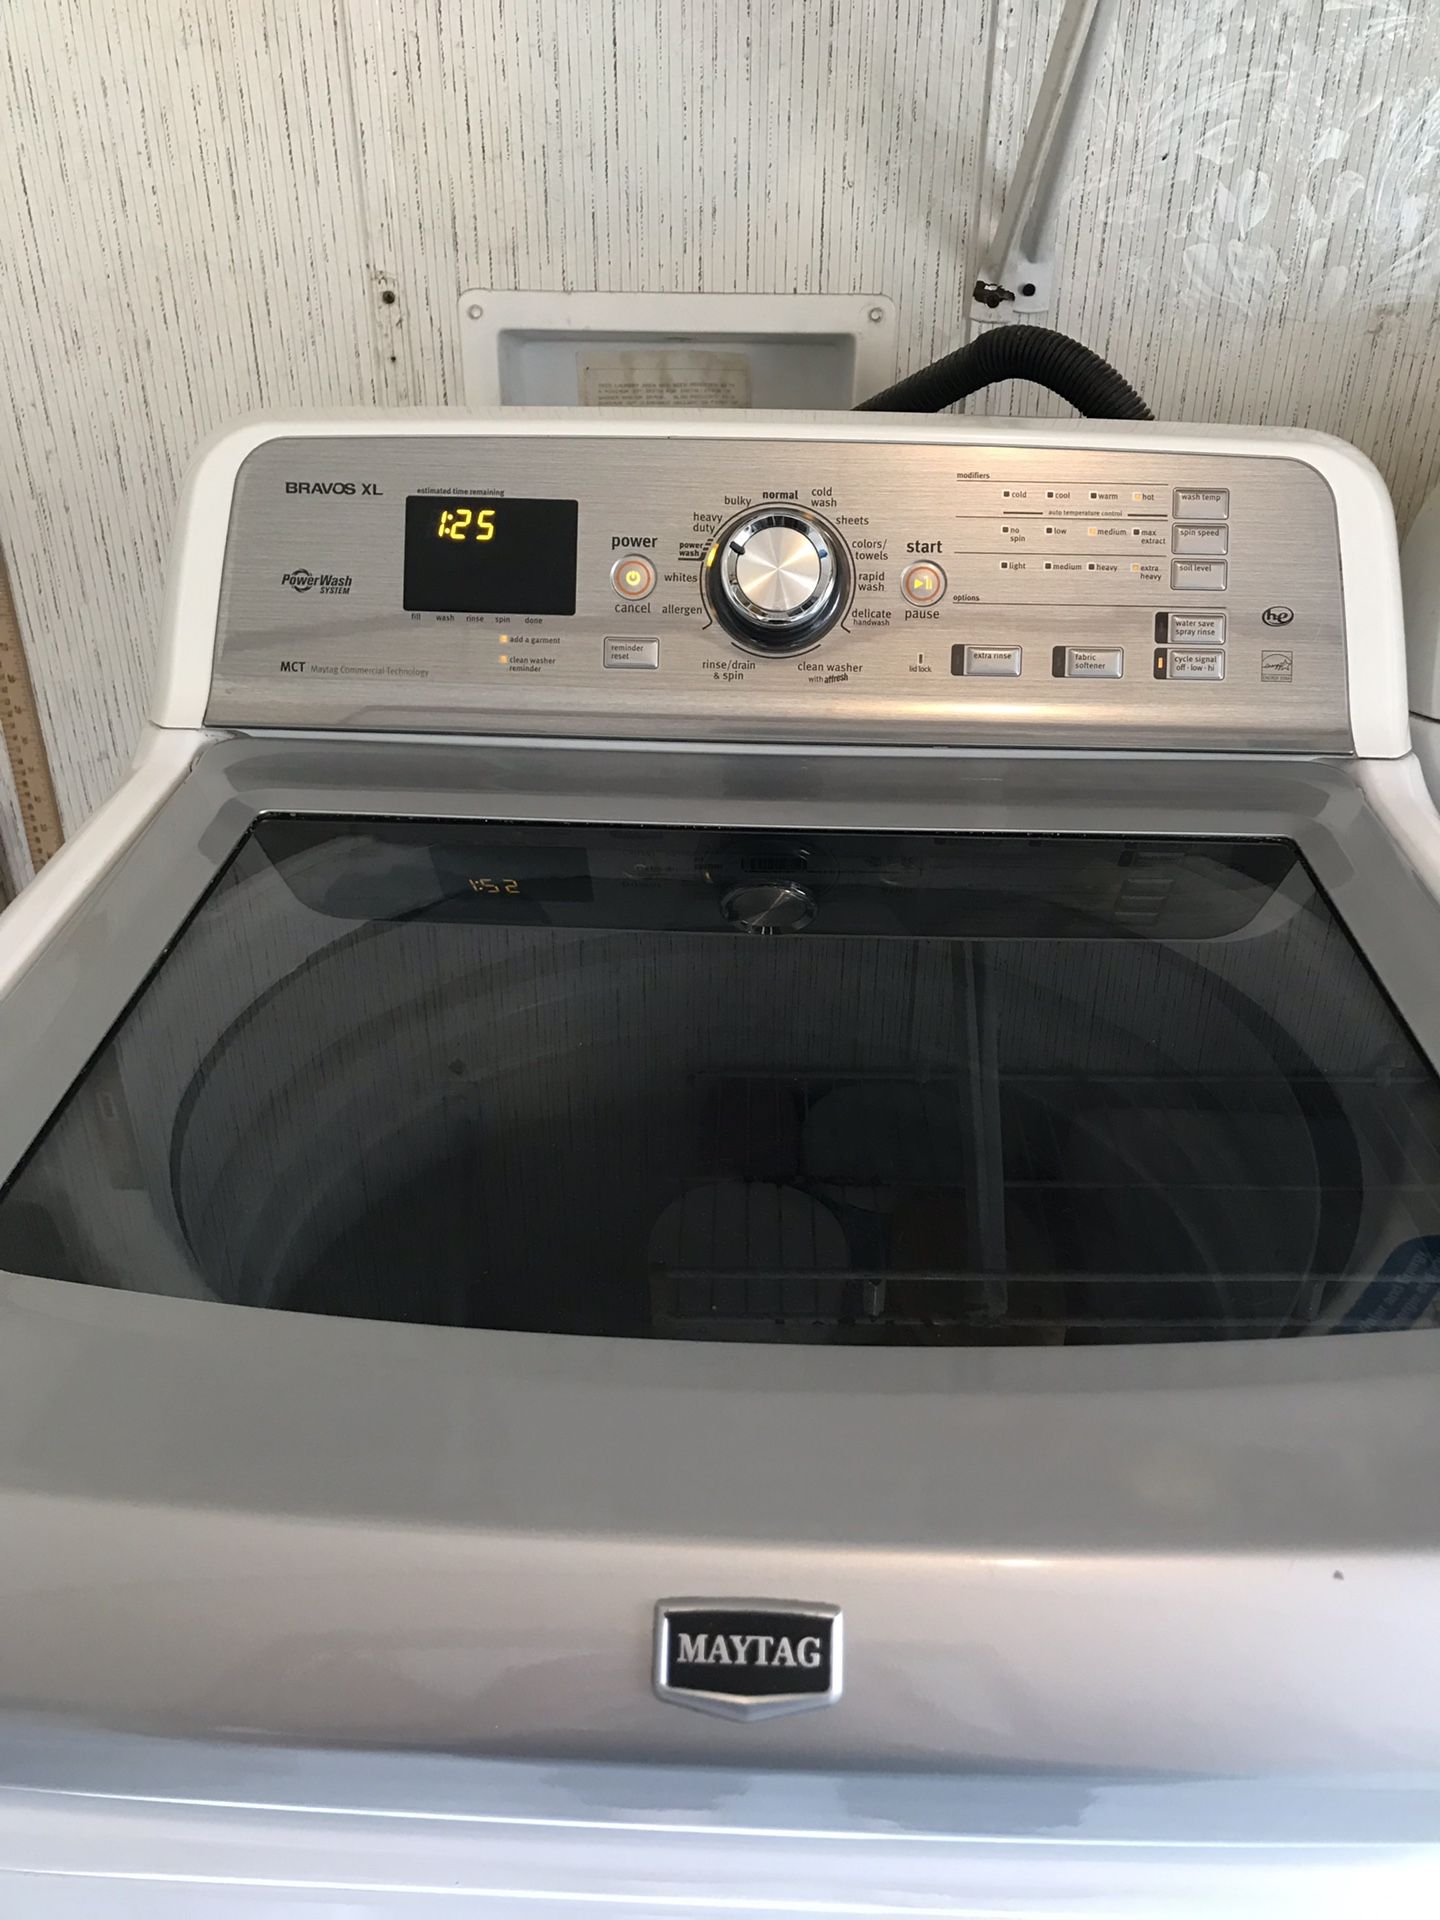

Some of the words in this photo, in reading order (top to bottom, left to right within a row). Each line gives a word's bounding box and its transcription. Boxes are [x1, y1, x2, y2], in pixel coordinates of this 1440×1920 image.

[286, 482, 356, 494] BRAVOS
[362, 483, 383, 495] XL
[470, 489, 504, 497] remaining
[812, 488, 832, 496] cold
[762, 490, 798, 499] normal
[1055, 491, 1070, 499] cool
[1142, 492, 1154, 501] hot
[1201, 493, 1221, 502] temp
[725, 496, 751, 506] bulky
[811, 498, 837, 507] wash
[693, 512, 722, 523] heavy
[836, 516, 869, 525] sheets
[438, 509, 495, 540] 1:25
[693, 523, 715, 534] duty
[1180, 529, 1196, 537] spin
[1198, 529, 1219, 538] speed
[611, 536, 657, 549] power
[1010, 535, 1025, 543] spin
[680, 542, 703, 551] power
[852, 539, 887, 549] colors/
[907, 540, 942, 553] start
[856, 551, 888, 560] towels
[1009, 562, 1026, 570] light
[1096, 563, 1117, 572] heavy
[1179, 564, 1193, 572] soil
[1195, 564, 1211, 572] level
[282, 574, 352, 586] PowerWash
[665, 572, 698, 582] whites
[859, 572, 885, 583] rapid
[1140, 572, 1161, 581] heavy
[858, 582, 884, 591] wash
[953, 594, 979, 602] options
[615, 603, 650, 614] cancel
[662, 604, 702, 616] allergen
[852, 609, 891, 618] delicate
[905, 609, 940, 621] pause
[495, 616, 510, 624] spin
[1176, 620, 1195, 628] water
[1176, 629, 1195, 637] spray
[1198, 628, 1215, 636] rinse
[531, 637, 560, 645] garment
[611, 644, 643, 652] reminder
[509, 656, 528, 664] clean
[993, 652, 1012, 660] rinse
[1174, 655, 1191, 664] cycle
[1193, 655, 1217, 664] signal
[702, 660, 755, 670] rinse/drain
[798, 662, 824, 672] clean
[826, 663, 863, 672] washer
[280, 662, 305, 672] MCT
[311, 665, 338, 675] Maytag
[340, 666, 384, 675] Commercial
[386, 667, 429, 678] Technology
[714, 672, 720, 680] &
[723, 672, 744, 681] spin
[677, 1633, 820, 1668] MAYTAG
